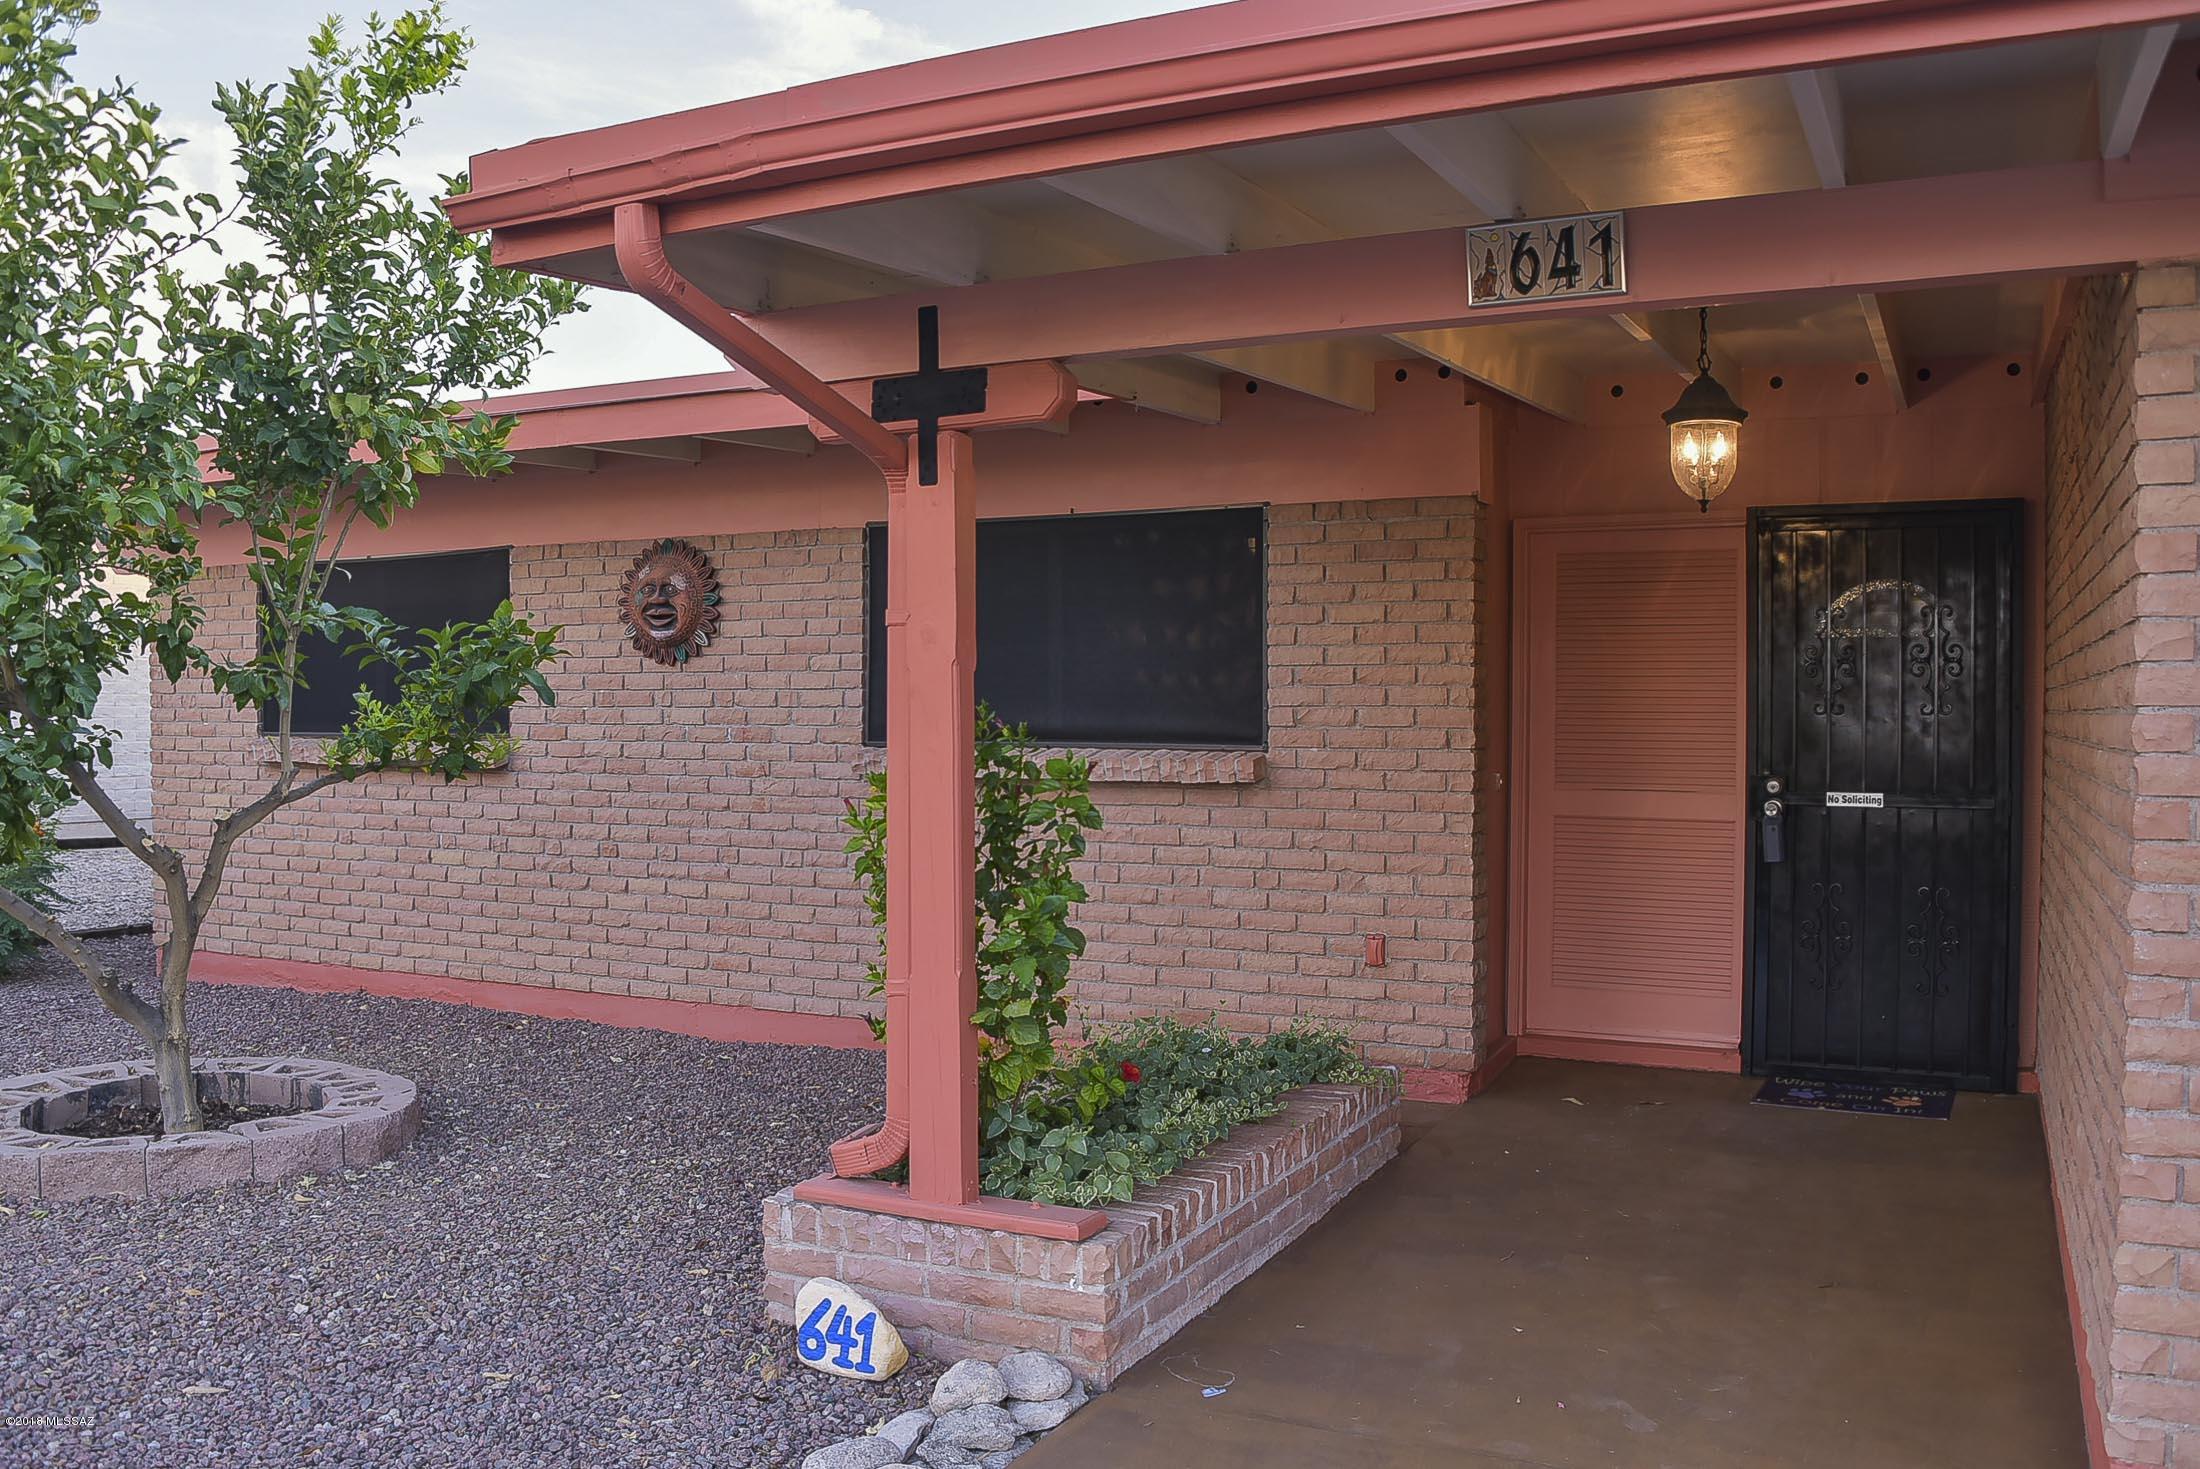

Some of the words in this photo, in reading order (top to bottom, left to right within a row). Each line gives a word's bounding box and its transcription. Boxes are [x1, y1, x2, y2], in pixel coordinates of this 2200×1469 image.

[1510, 221, 1614, 295] 641
[1828, 795, 1839, 803] No
[1841, 795, 1882, 806] Soliciting
[1775, 1076, 1826, 1087] Wipe
[799, 1298, 876, 1374] 641
